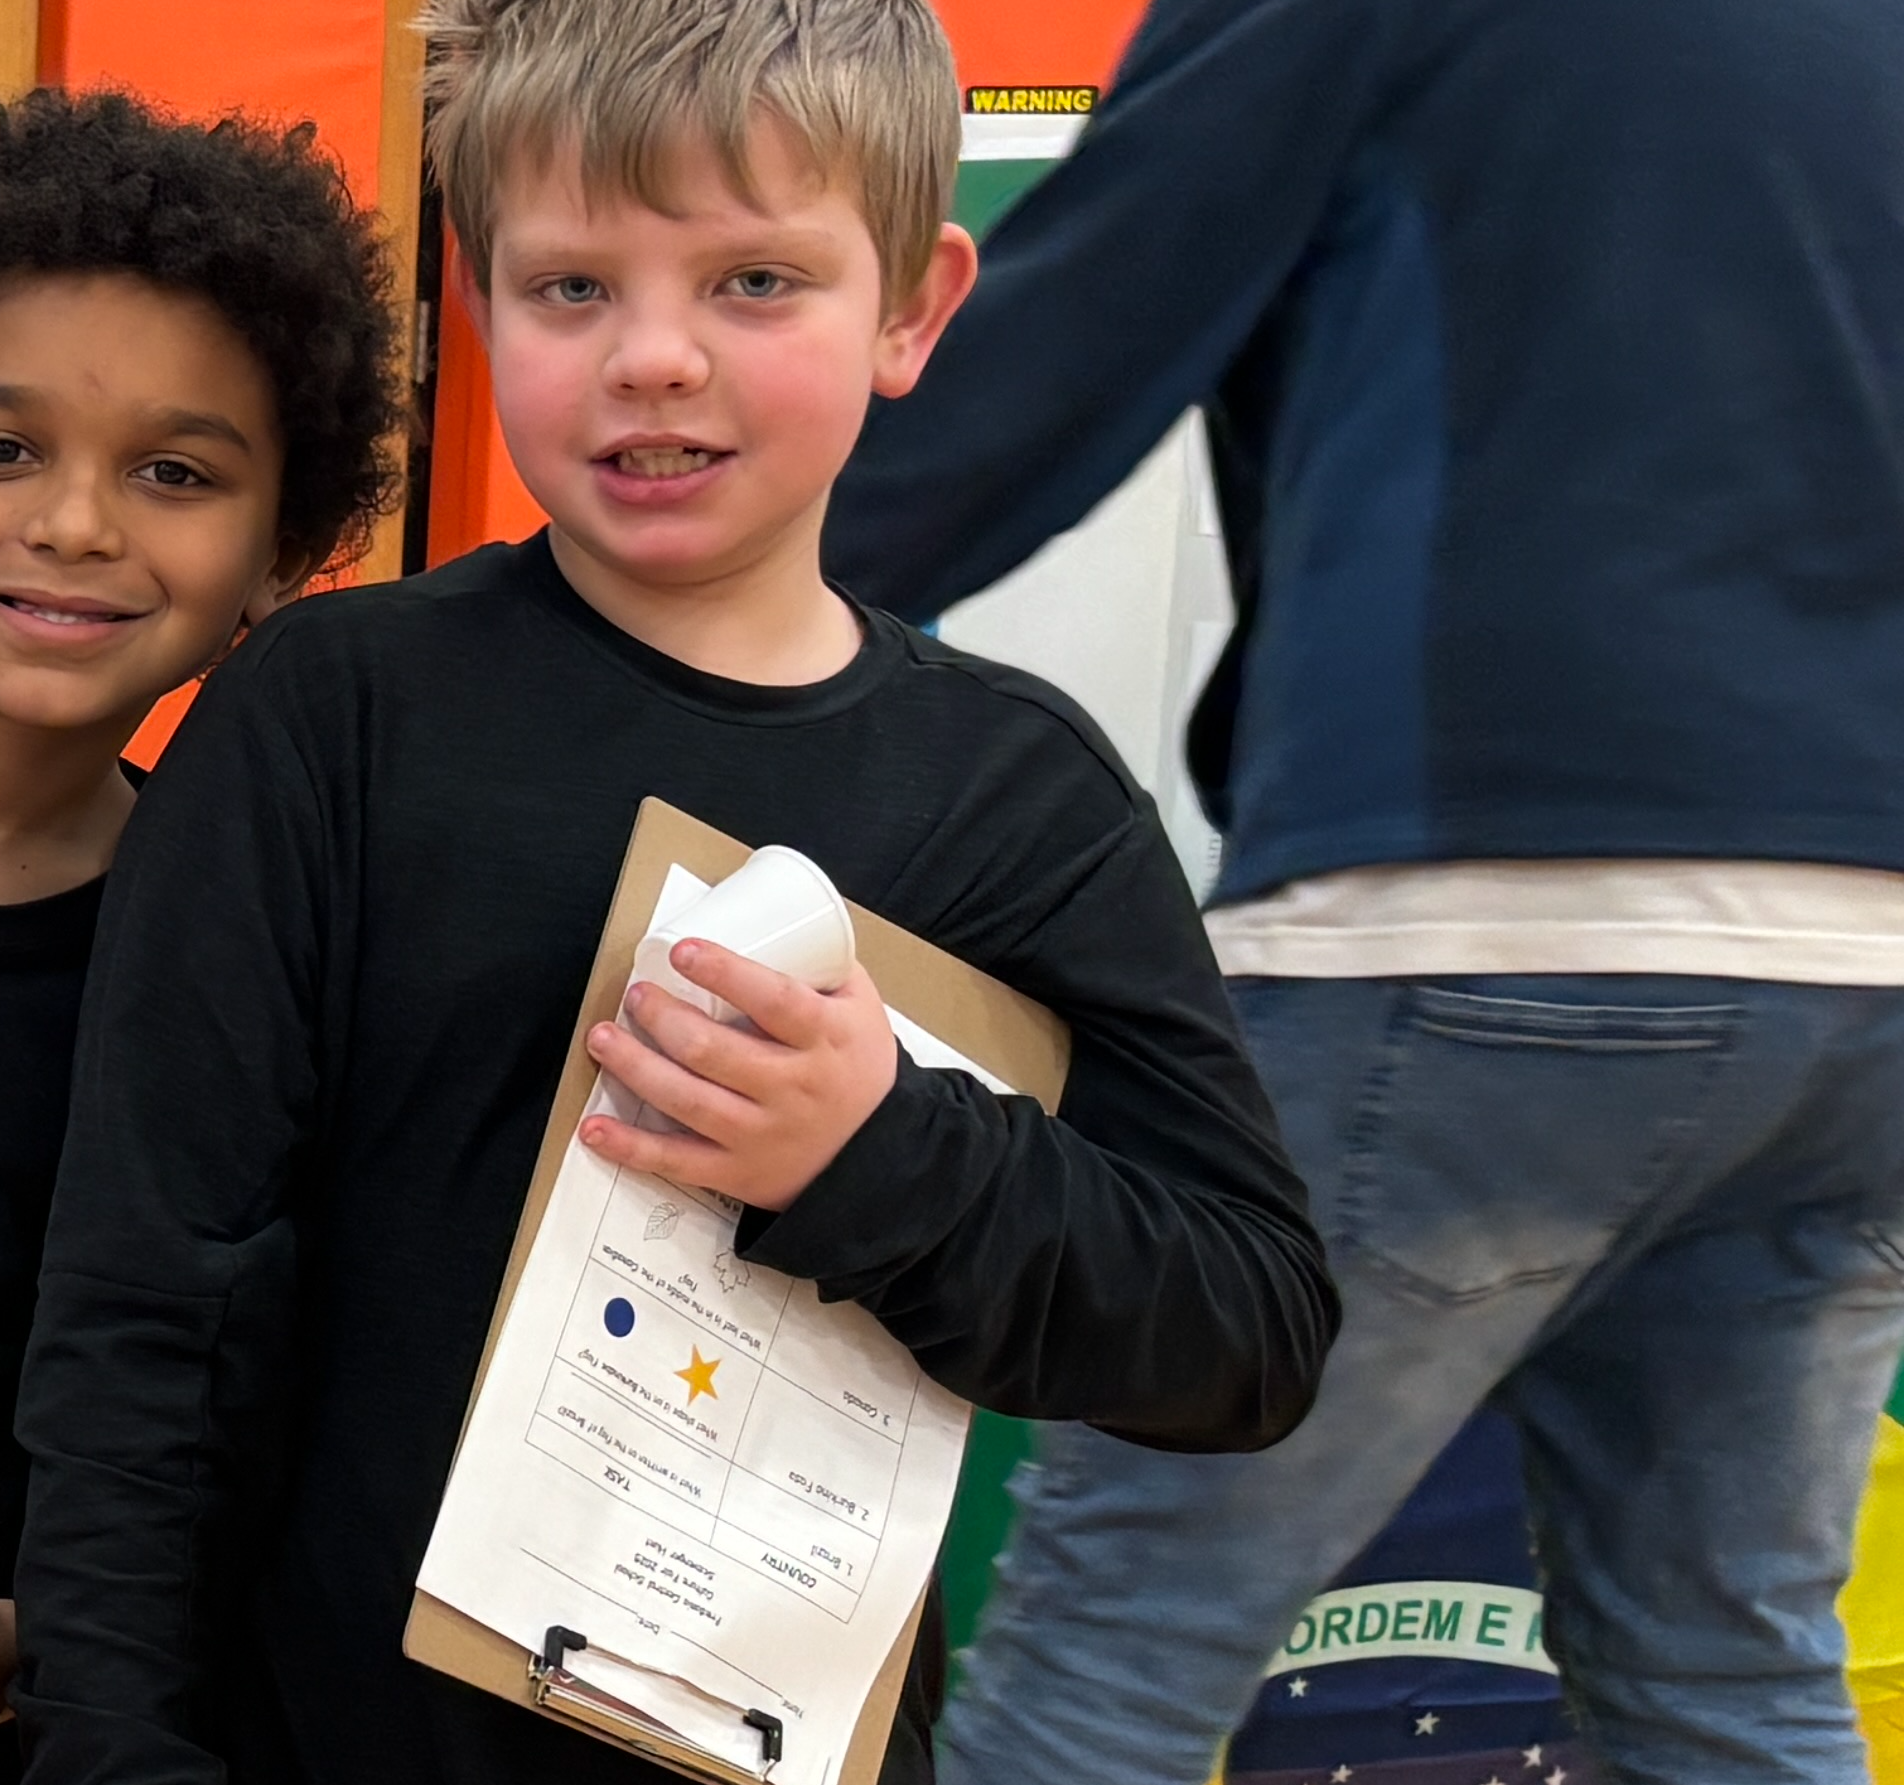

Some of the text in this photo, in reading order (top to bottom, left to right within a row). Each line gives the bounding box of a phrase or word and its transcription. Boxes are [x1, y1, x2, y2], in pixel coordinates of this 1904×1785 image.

[970, 88, 1093, 114] WARNING
[842, 1390, 878, 1419] Canada
[603, 1465, 817, 1589] COUNTRY TASK
[810, 1544, 842, 1570] Brazil
[1283, 1598, 1465, 1657] ORDEM
[1475, 1602, 1514, 1648] E
